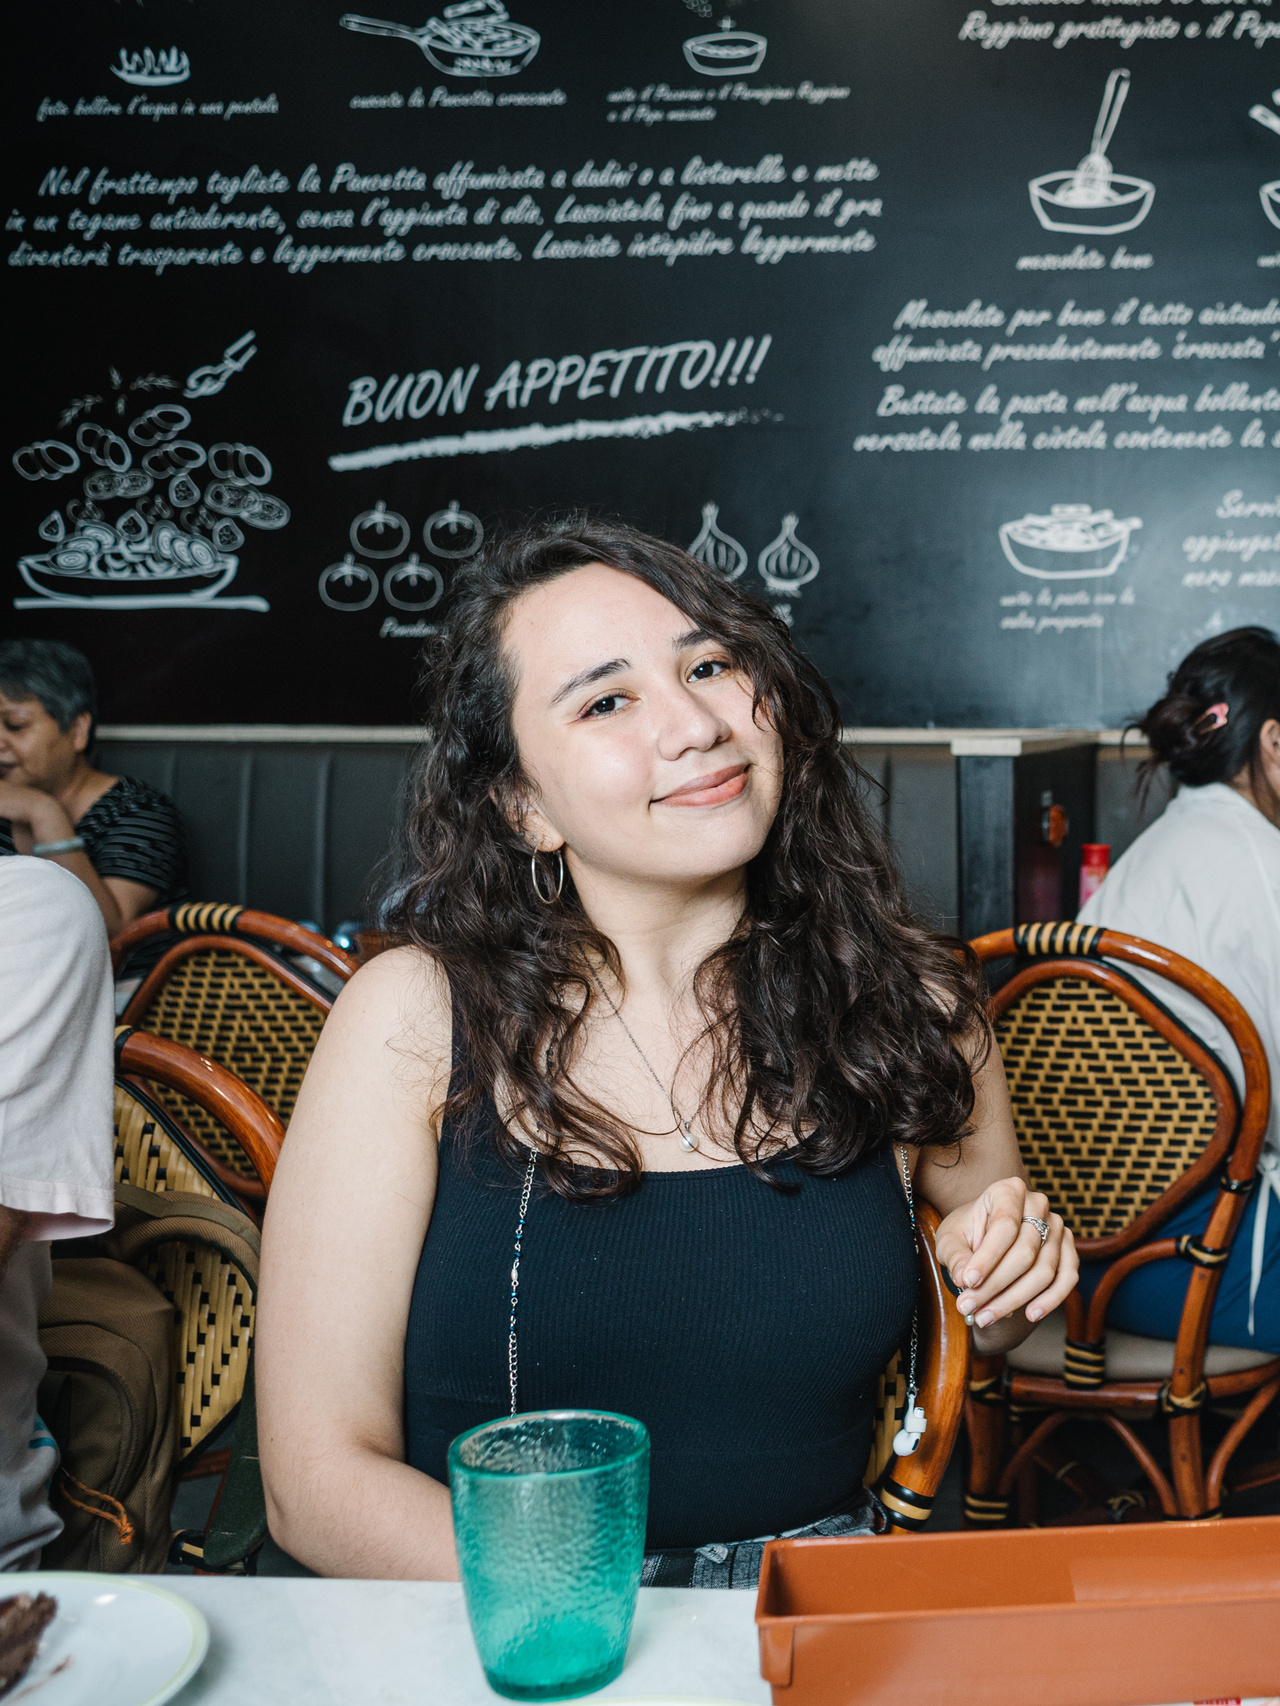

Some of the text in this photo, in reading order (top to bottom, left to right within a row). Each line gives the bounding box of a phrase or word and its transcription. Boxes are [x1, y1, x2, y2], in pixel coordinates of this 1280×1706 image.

[958, 10, 1055, 49] Reggiano
[1053, 15, 1181, 49] grattugiato
[1184, 22, 1201, 39] e
[1205, 10, 1235, 39] il
[37, 154, 880, 204] Nel frattempo tagliate la Pancetta affumicata a dadini o a listarelle e mette
[4, 187, 883, 241] in un tegame antiaderente, senza l'aggiunta di olio. Lasciatela fino a quando il gra
[7, 239, 112, 268] diventerà
[117, 242, 244, 277] trasparente
[249, 246, 267, 265] e
[272, 234, 407, 274] leggermente
[412, 235, 522, 262] croccante.
[532, 229, 622, 260] Lasciate
[740, 224, 877, 265] leggermente
[893, 298, 1006, 331] Mescolate
[1005, 308, 1052, 337] per
[1056, 298, 1106, 328] bene
[1109, 297, 1140, 326] il
[1138, 301, 1194, 326] tutto
[871, 333, 984, 373] affumicata
[981, 333, 1162, 372] precedentemente
[340, 333, 773, 427] BUON APPETITO!!!
[876, 384, 969, 417] Buttate
[974, 383, 1001, 414] la
[1001, 388, 1068, 424] pasta
[1073, 381, 1189, 424] nell'acqua
[853, 419, 962, 452] versatela
[966, 419, 1027, 452] nella
[1032, 418, 1108, 451] ciotola
[1112, 423, 1233, 450] contenente
[1240, 418, 1266, 449] la
[1182, 569, 1234, 590] nero
